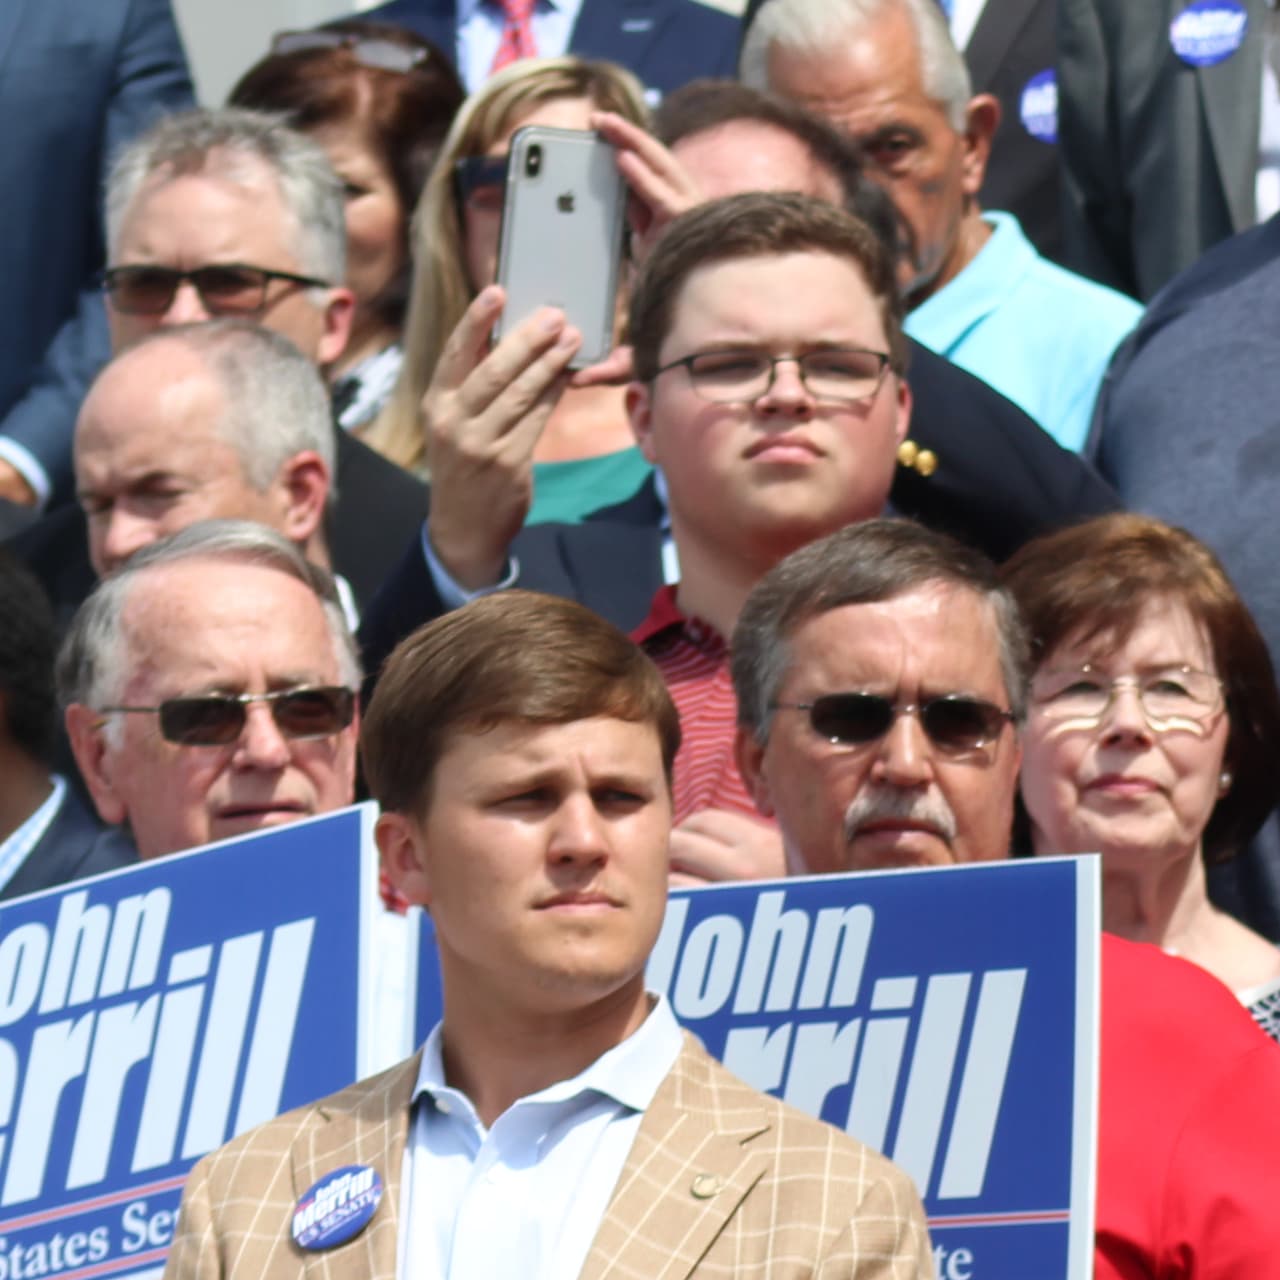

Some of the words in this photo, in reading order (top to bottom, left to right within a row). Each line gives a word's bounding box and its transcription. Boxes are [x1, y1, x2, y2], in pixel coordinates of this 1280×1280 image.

[0, 887, 172, 1030] ohn
[0, 917, 316, 1203] rrill
[293, 1167, 374, 1238] Merrill
